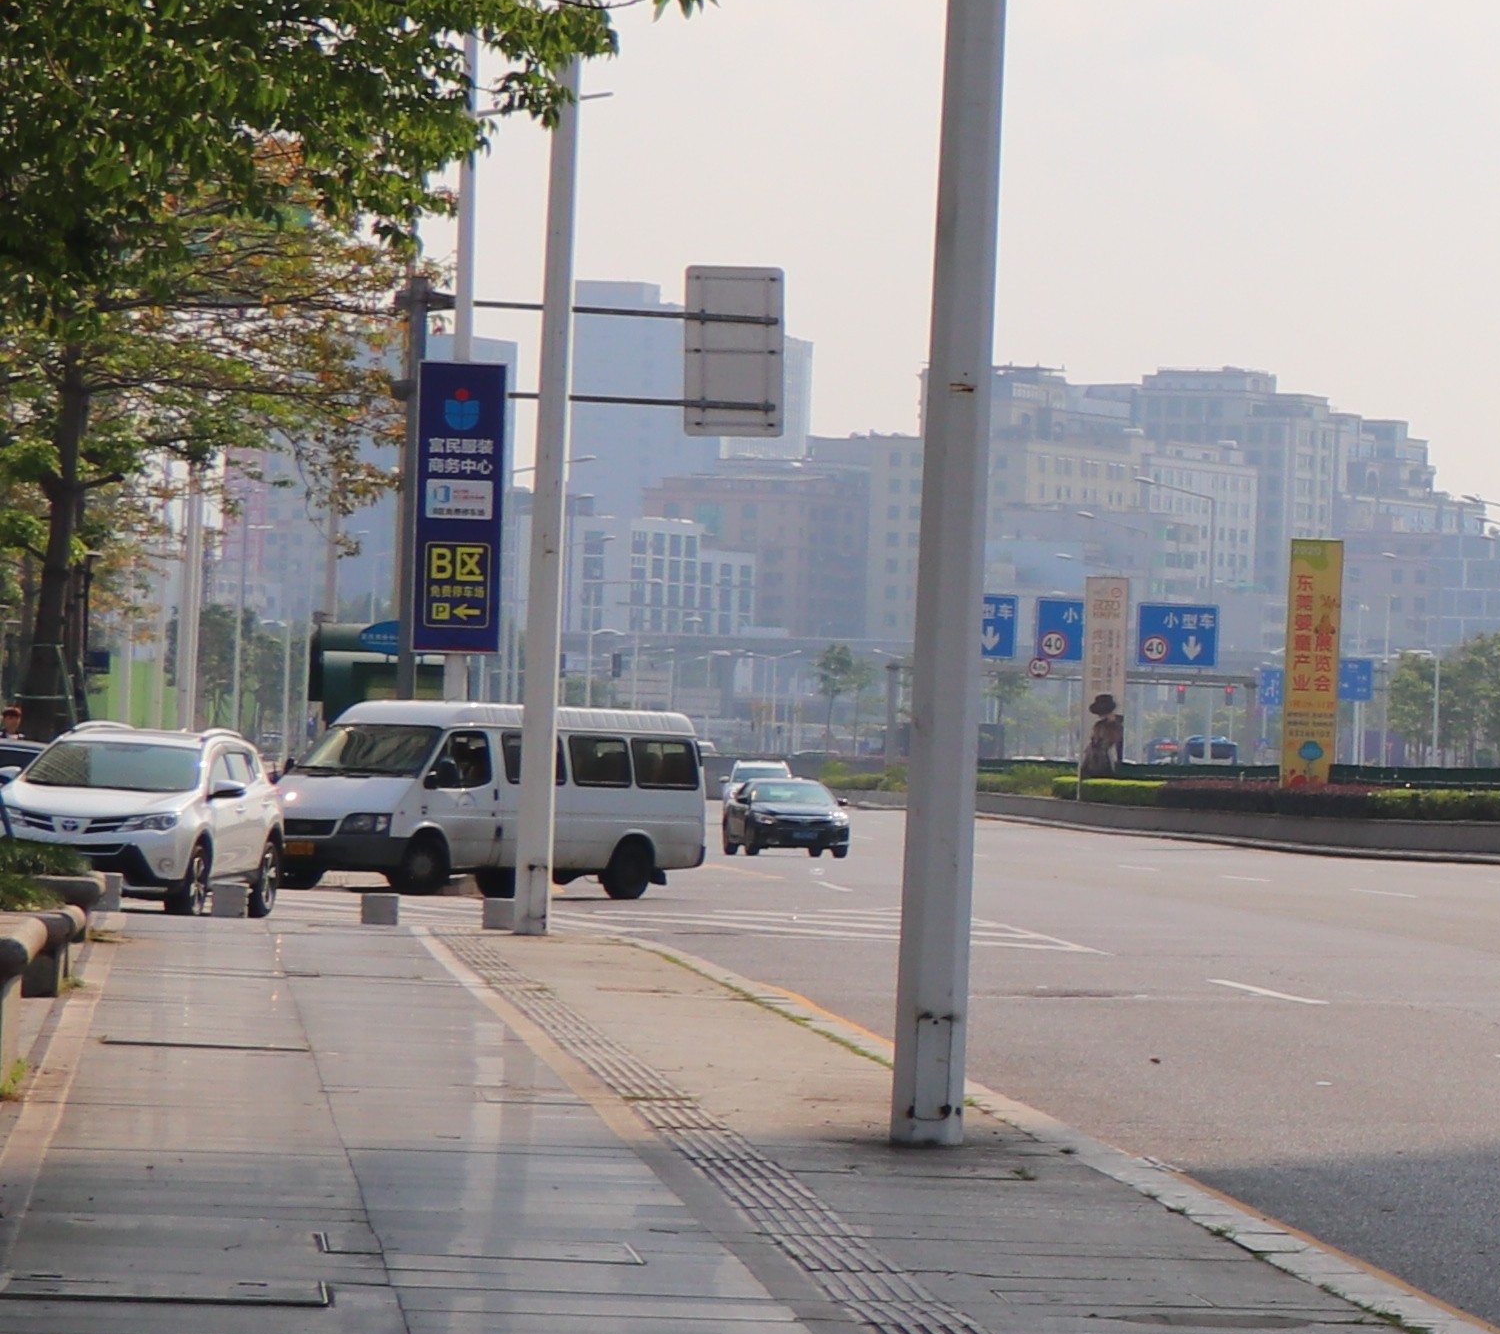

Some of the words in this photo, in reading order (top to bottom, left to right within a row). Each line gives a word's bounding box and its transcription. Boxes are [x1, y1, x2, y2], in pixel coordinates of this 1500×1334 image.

[428, 438, 494, 455] 富民服装
[428, 458, 493, 475] 商务中心
[430, 547, 484, 582] B区
[430, 586, 485, 599] 免费停车场
[1163, 612, 1214, 629] 小型车
[1043, 637, 1064, 651] 40
[1144, 641, 1166, 655] 40
